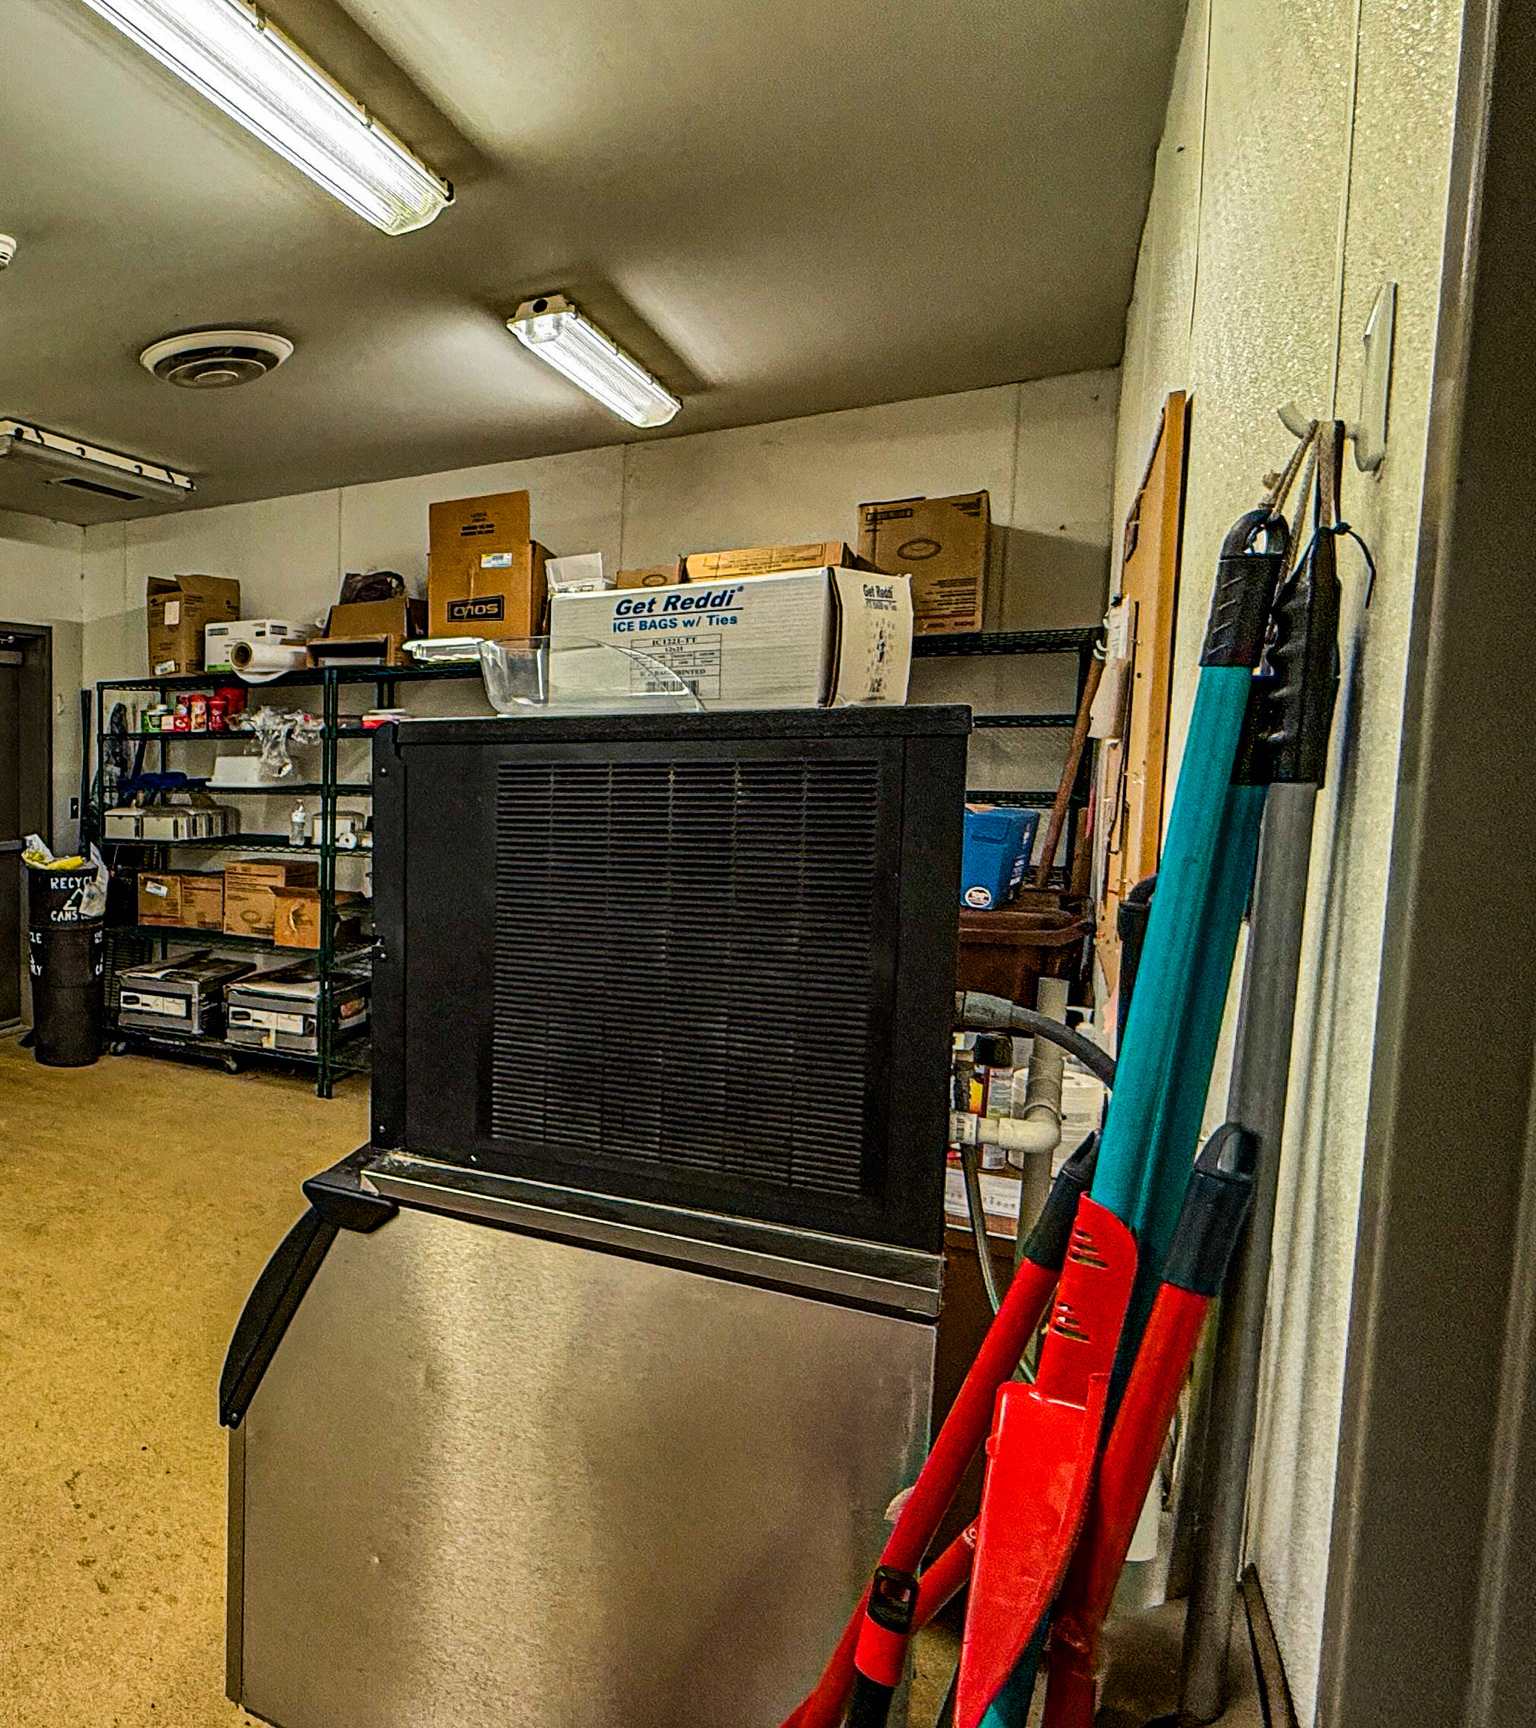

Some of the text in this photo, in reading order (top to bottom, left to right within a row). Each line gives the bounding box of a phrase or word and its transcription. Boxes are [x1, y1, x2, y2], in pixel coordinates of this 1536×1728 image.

[863, 584, 875, 598] Get
[615, 590, 736, 615] Get Reddi
[613, 614, 738, 633] ICE BAGS w/ Ties
[50, 910, 79, 922] CANS
